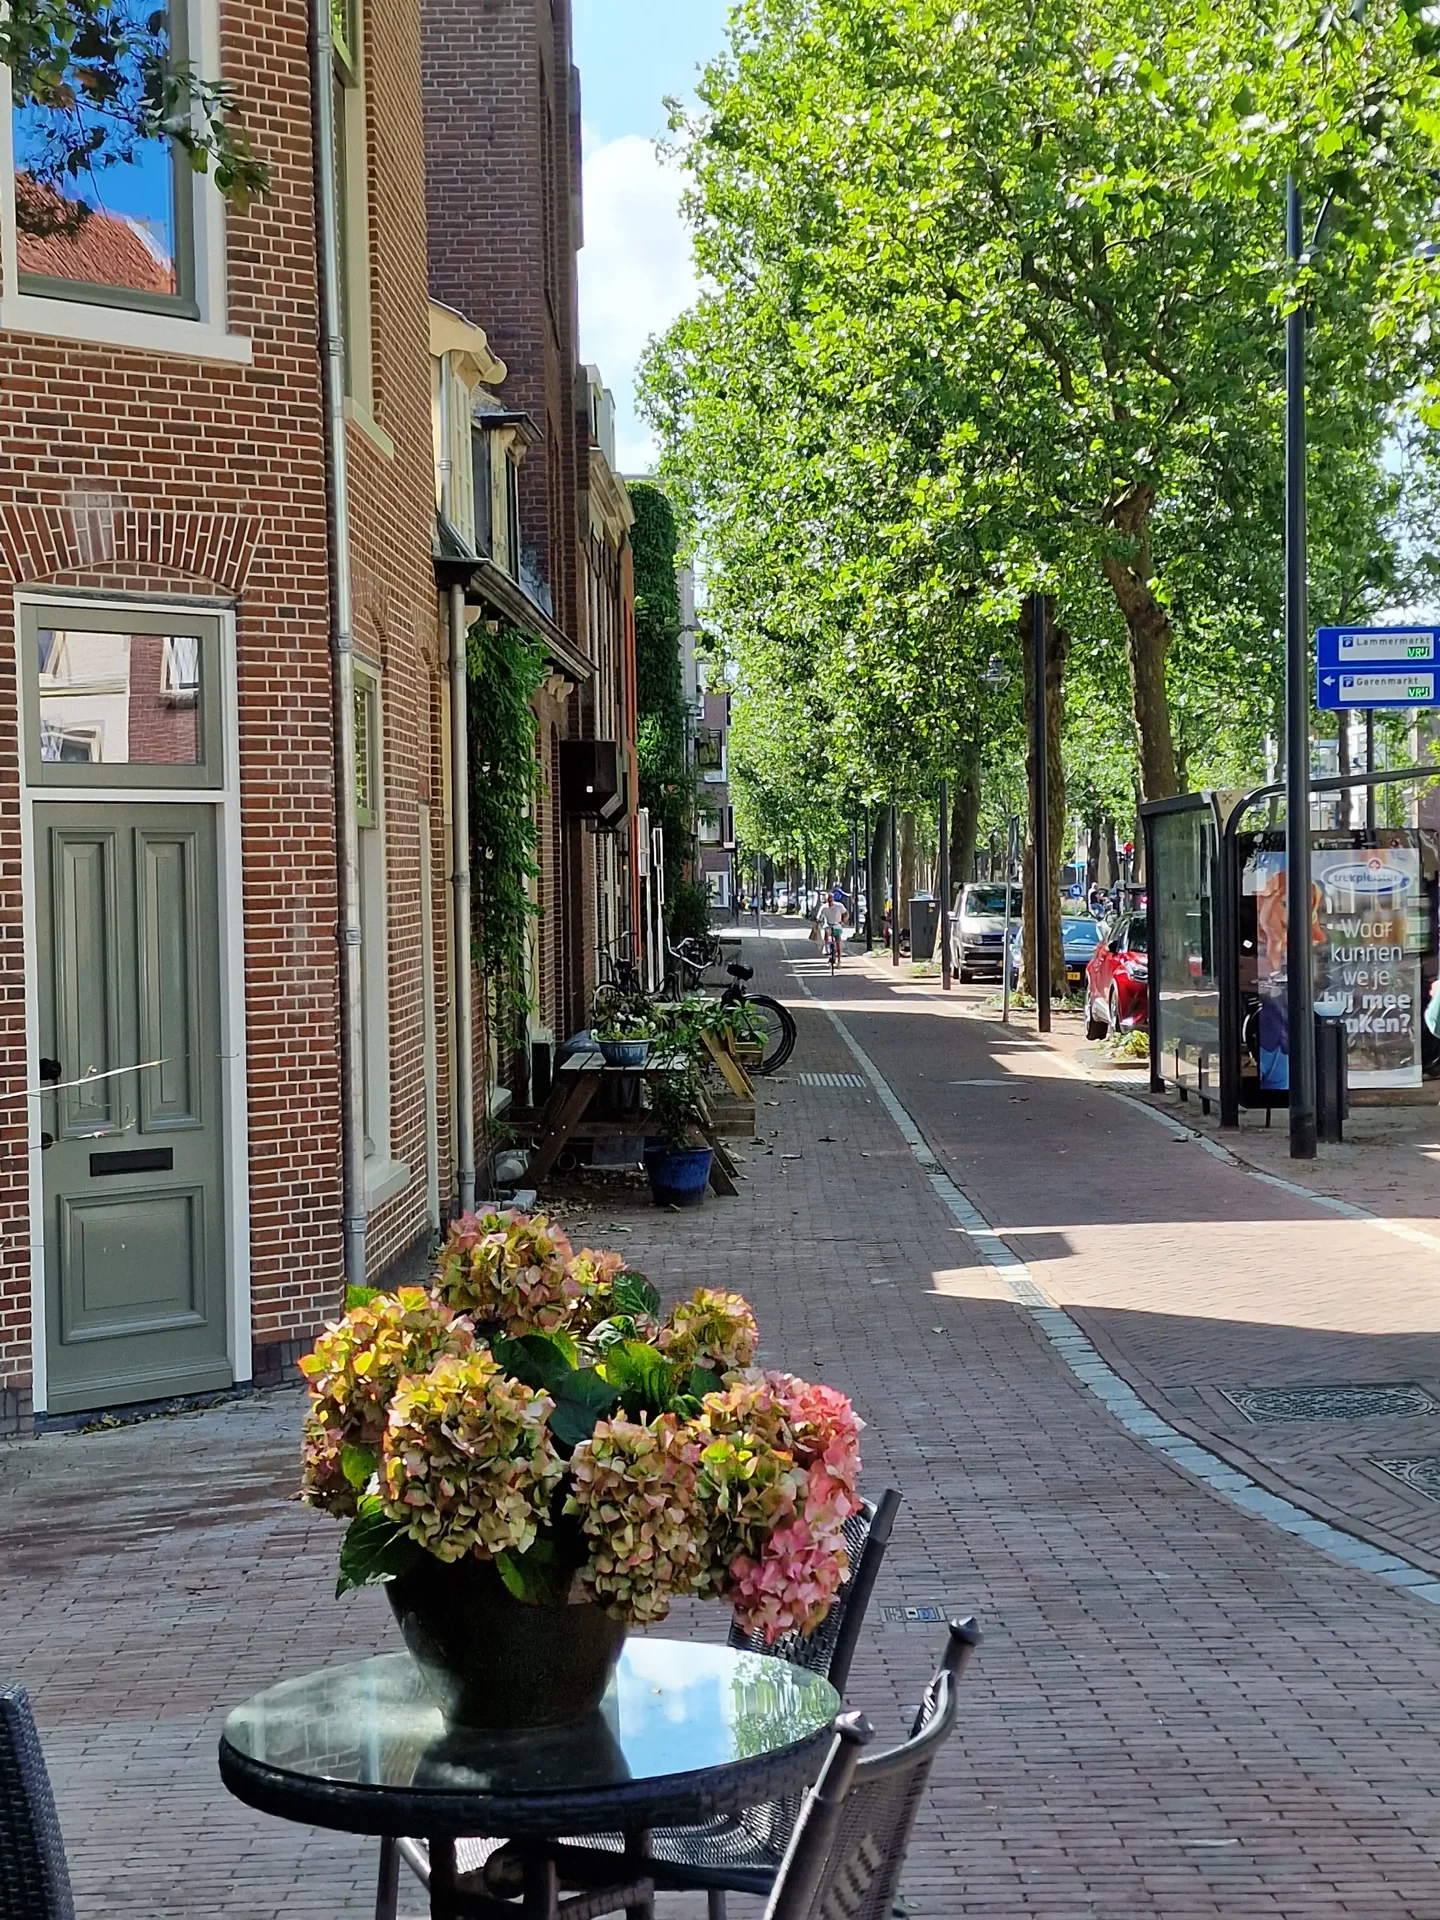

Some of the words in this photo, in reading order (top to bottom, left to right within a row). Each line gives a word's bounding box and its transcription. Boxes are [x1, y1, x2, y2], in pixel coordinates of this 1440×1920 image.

[1356, 636, 1430, 646] Lammermarkt
[1356, 676, 1418, 687] Garenmarkt
[1340, 918, 1393, 938] Waar
[1331, 943, 1402, 962] kunnen
[1343, 970, 1369, 986] we
[1372, 965, 1390, 991] je
[1362, 993, 1411, 1009] mee
[1340, 1013, 1411, 1034] aken?
